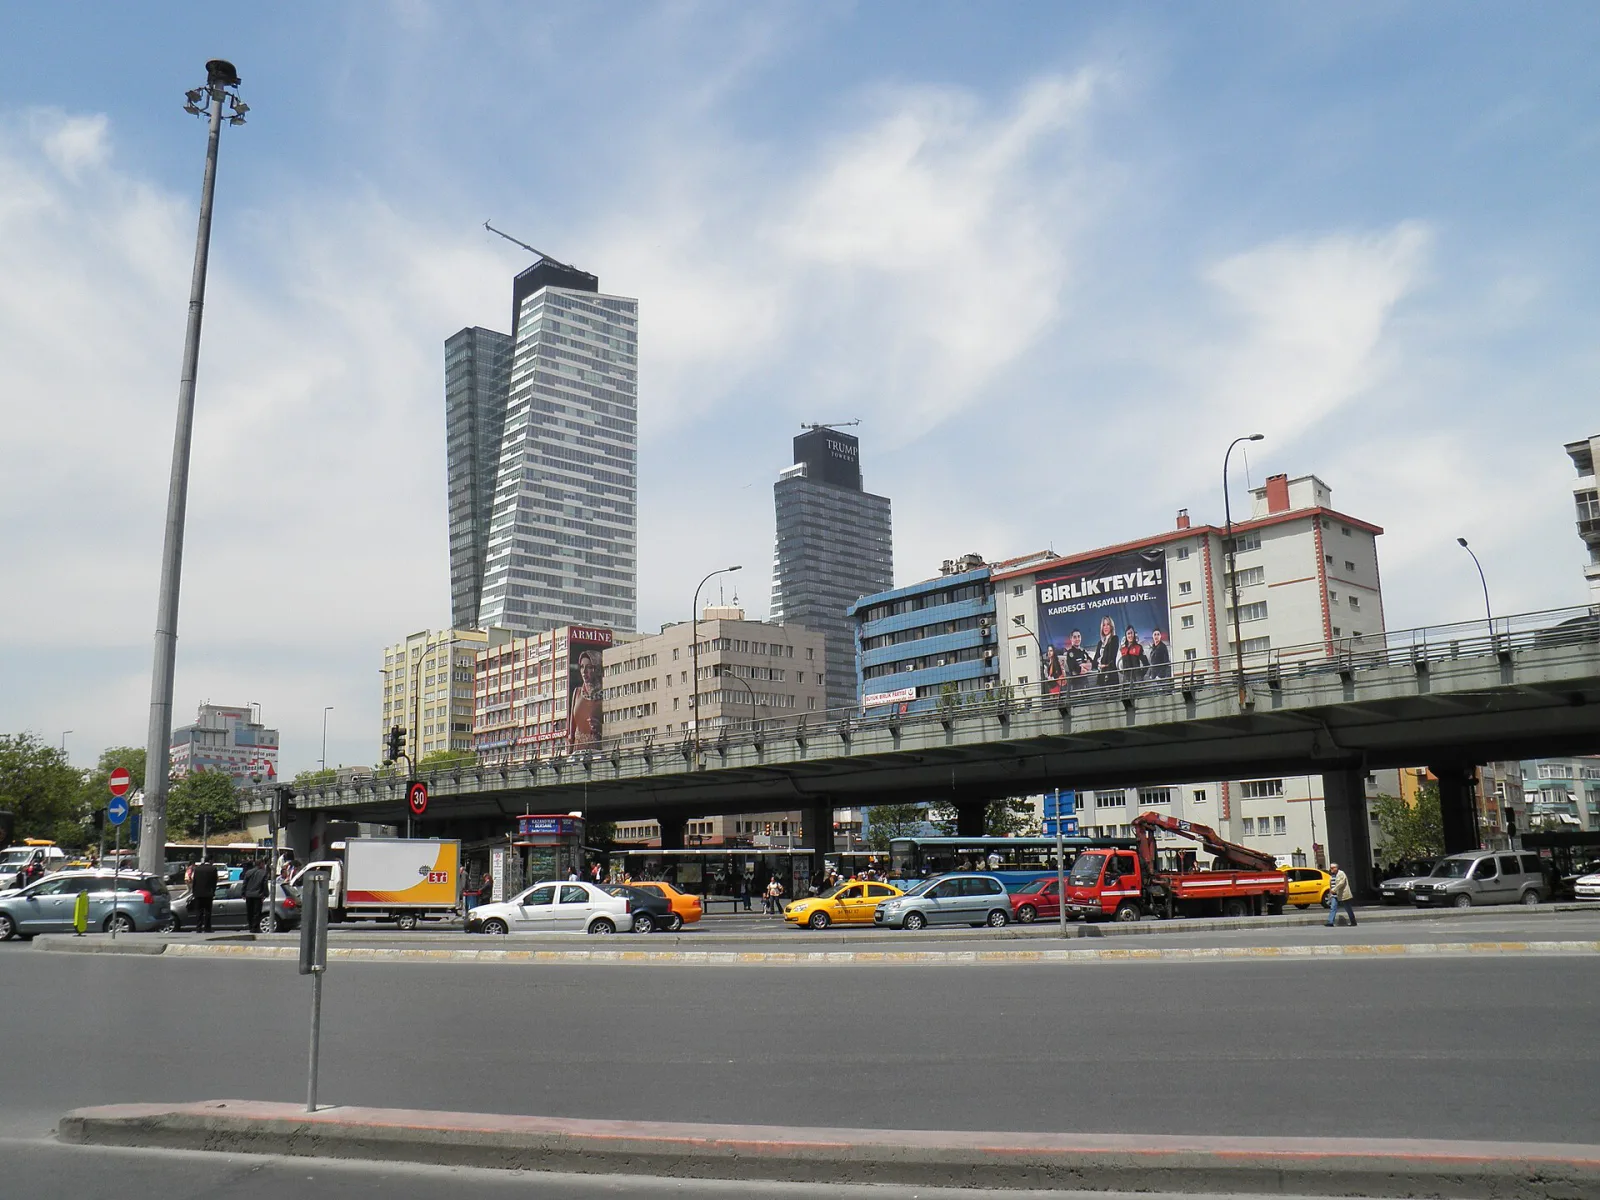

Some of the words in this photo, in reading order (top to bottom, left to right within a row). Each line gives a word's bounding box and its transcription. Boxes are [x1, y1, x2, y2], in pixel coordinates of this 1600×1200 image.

[826, 438, 858, 456] TRUMP
[831, 451, 855, 462] TOWERS
[1040, 567, 1162, 604] BİRLİKTEYİZ!
[1048, 602, 1086, 616] KARDEŞÇE
[1087, 595, 1129, 610] YAŞAYALIM
[1130, 592, 1157, 604] DİYE...
[571, 629, 612, 642] ARMİNE
[413, 791, 424, 805] 30
